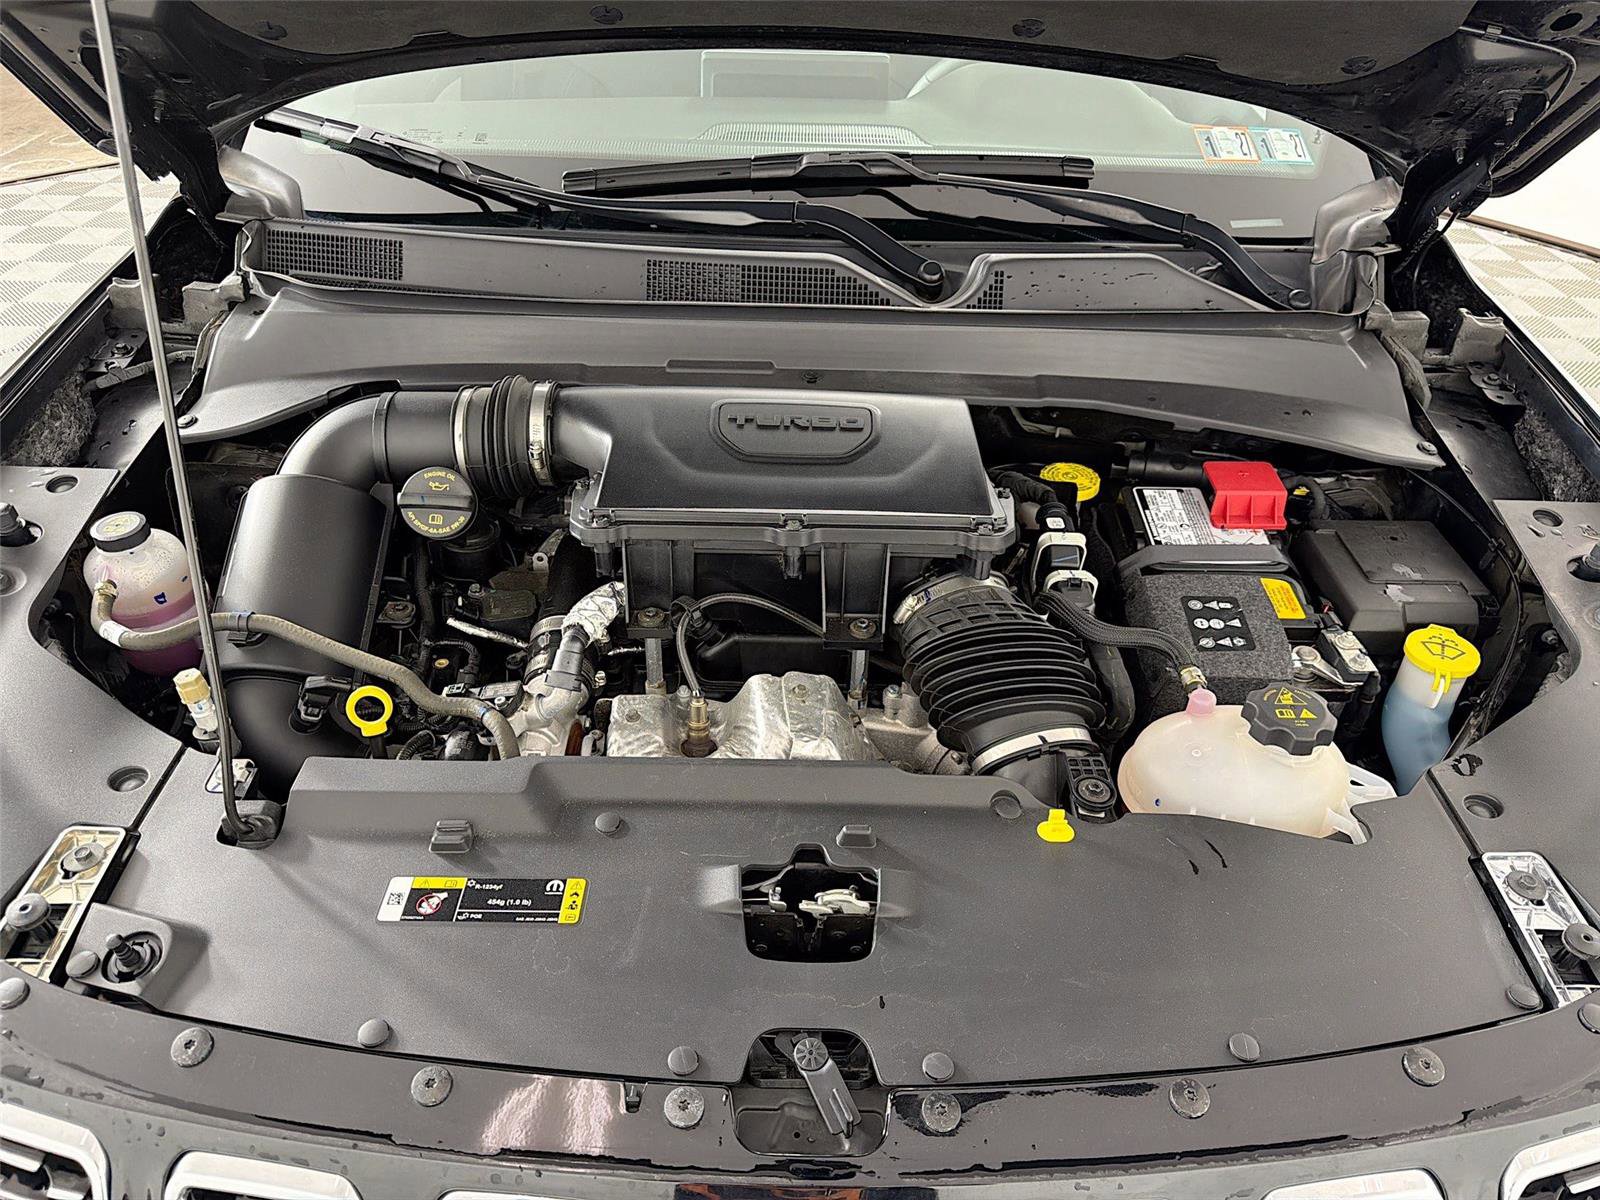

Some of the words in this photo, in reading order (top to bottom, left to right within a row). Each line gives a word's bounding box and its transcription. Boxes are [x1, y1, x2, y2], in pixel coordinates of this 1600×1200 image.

[727, 414, 866, 431] TURBO
[423, 471, 446, 479] ENGINE
[446, 473, 456, 482] OIL
